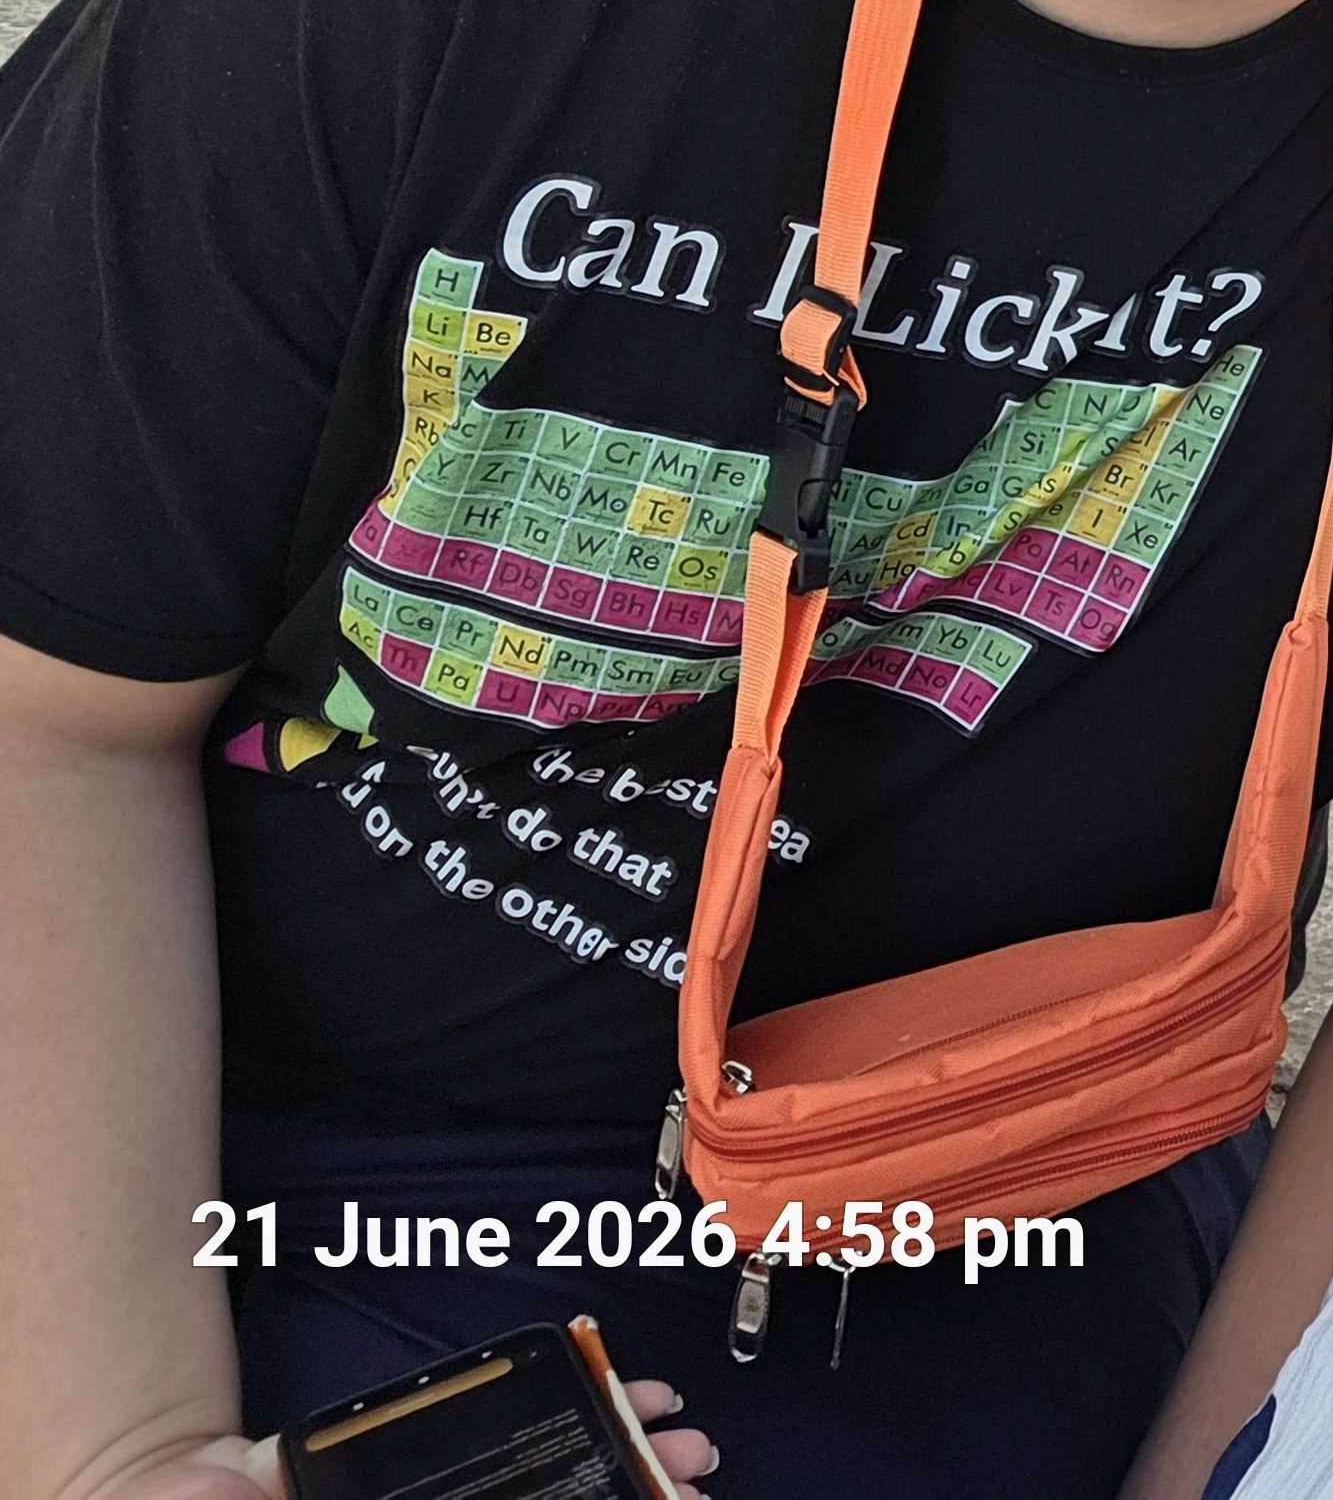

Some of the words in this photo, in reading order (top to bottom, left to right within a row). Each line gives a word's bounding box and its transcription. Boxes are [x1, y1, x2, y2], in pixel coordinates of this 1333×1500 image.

[435, 269, 459, 292] H
[503, 179, 719, 307] Can
[851, 241, 1110, 372] Lick
[426, 313, 449, 336] Li
[476, 322, 511, 345] Be
[412, 351, 452, 378] Na
[462, 367, 489, 386] M
[1035, 389, 1056, 409] C
[1085, 394, 1107, 415] N
[1186, 394, 1224, 420] Ne
[424, 390, 440, 405] K
[505, 421, 528, 440] Ti
[561, 427, 580, 449] V
[605, 442, 641, 466] Cr
[652, 451, 697, 479] Mn
[712, 462, 746, 487] Fe
[1020, 432, 1047, 454] Si
[1168, 439, 1201, 462] Ar
[415, 417, 439, 445] Rb
[438, 453, 455, 477] Y
[480, 462, 516, 484] Zr
[530, 468, 571, 501] Nb
[578, 486, 628, 513] Mo
[649, 499, 675, 525] Tc
[697, 508, 730, 536] Ru
[865, 488, 903, 511] Cu
[954, 475, 989, 494] Ga
[1002, 477, 1023, 497] G
[1104, 465, 1136, 488] Br
[1150, 480, 1180, 505] Kr
[463, 505, 504, 530] Hf
[523, 516, 549, 544] Ta
[577, 532, 607, 557] W
[626, 545, 660, 571] Re
[678, 556, 718, 580] Os
[897, 518, 931, 540] Cd
[1092, 509, 1104, 528] I
[1126, 521, 1158, 549] Xe
[451, 550, 484, 574] Rf
[500, 563, 538, 591] Db
[554, 579, 591, 610] Sg
[608, 592, 645, 617] Bh
[664, 602, 700, 626] Hs
[835, 571, 869, 586] Au
[1013, 533, 1042, 557] Po
[1061, 553, 1091, 574] At
[1105, 564, 1135, 594] Rn
[354, 584, 378, 612] La
[396, 606, 434, 630] Ce
[455, 619, 484, 647] Pr
[499, 635, 545, 665] Nd
[553, 650, 598, 676] Pm
[608, 660, 655, 685] Sm
[669, 669, 702, 686] Eu
[718, 665, 740, 682] G
[994, 573, 1022, 597] Lv
[1044, 590, 1065, 616] Ts
[1080, 609, 1116, 642] Og
[348, 621, 374, 648] Ac
[390, 648, 418, 671] Th
[438, 663, 470, 691] Pa
[498, 683, 517, 701] U
[540, 693, 584, 720] Np
[938, 625, 968, 650] Yb
[982, 640, 1012, 667] Lu
[910, 664, 947, 690] No
[960, 682, 982, 708] Lr
[365, 805, 413, 857] on
[424, 840, 494, 900] the
[501, 888, 620, 961] other
[507, 807, 562, 851] do
[573, 827, 672, 896] that
